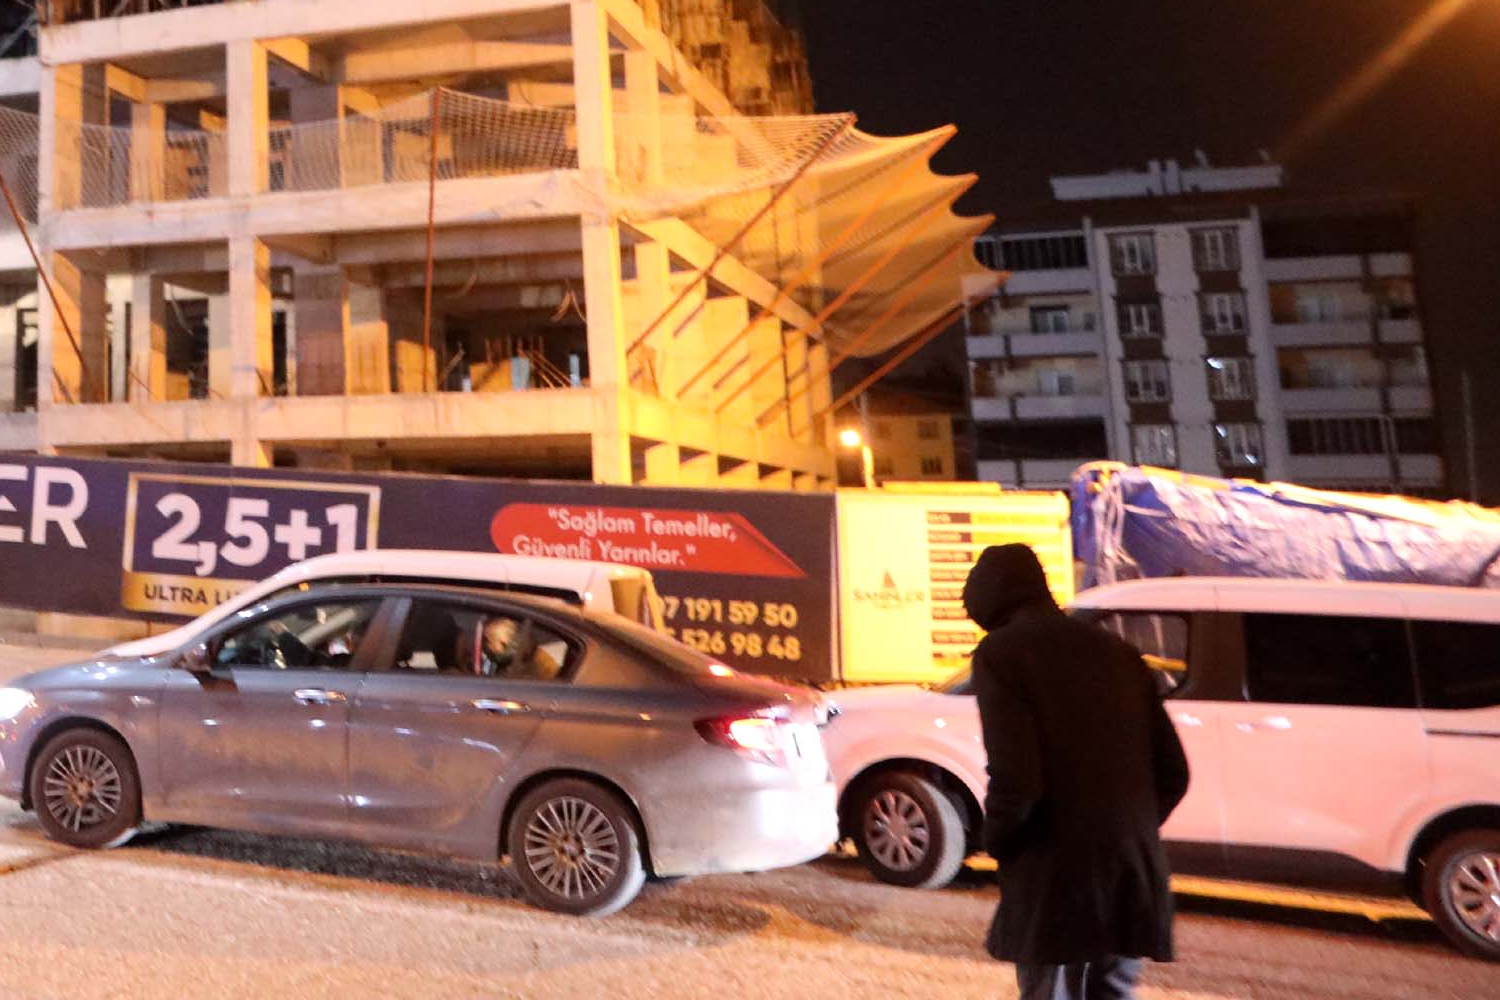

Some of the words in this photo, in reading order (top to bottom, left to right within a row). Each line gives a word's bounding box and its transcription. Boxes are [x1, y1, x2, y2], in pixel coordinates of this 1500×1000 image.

[144, 583, 208, 605] ULTRA
[683, 597, 722, 624] 191
[728, 600, 758, 625] 59
[763, 602, 799, 629] 50
[729, 631, 762, 658] 98
[766, 634, 801, 661] 48
